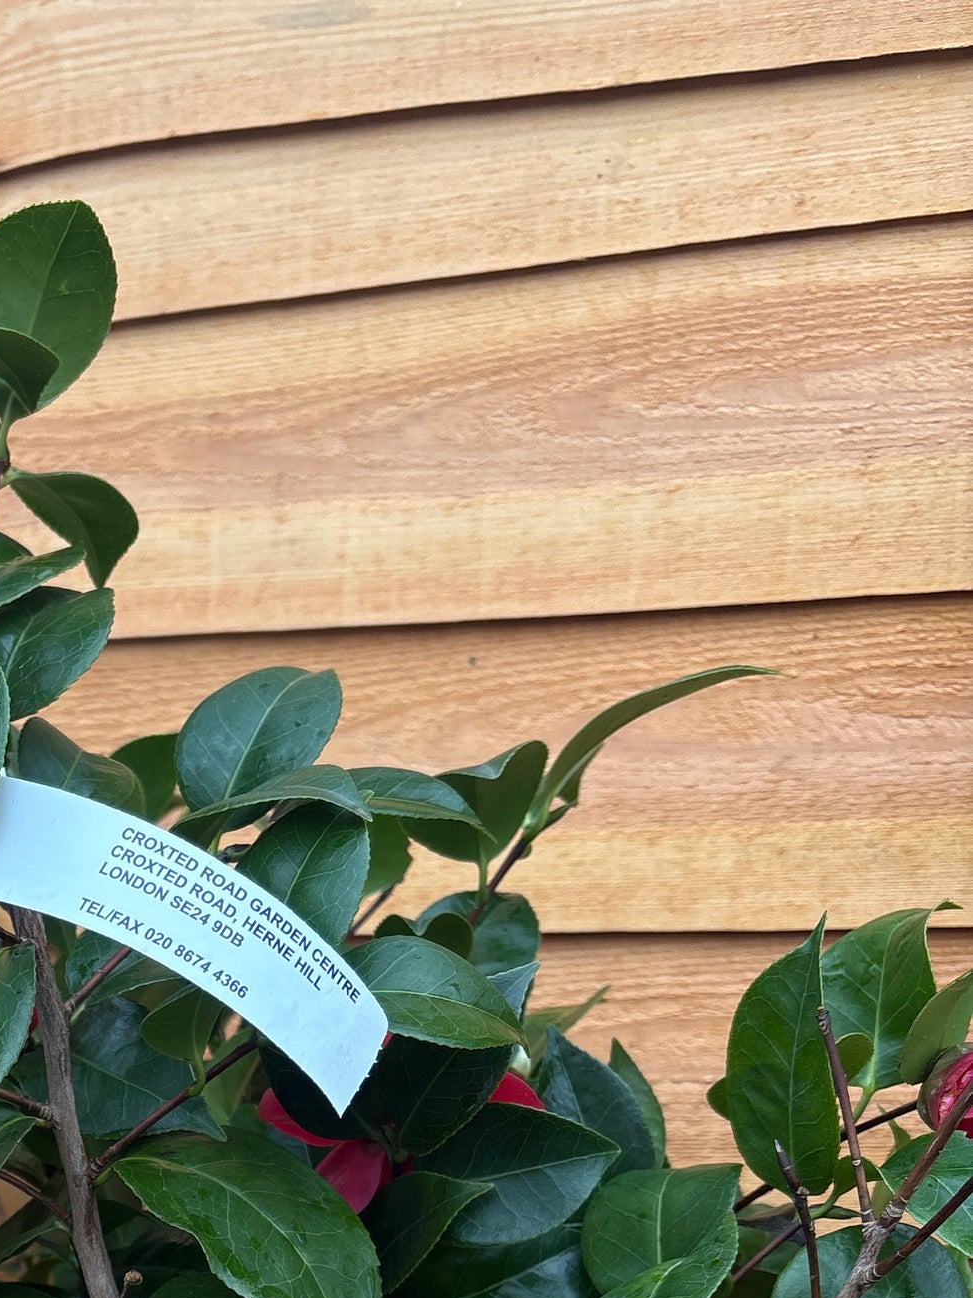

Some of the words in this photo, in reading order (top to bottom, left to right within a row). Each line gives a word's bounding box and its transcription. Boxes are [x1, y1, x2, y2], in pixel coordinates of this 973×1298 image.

[79, 897, 144, 935] TEL/FAX
[144, 927, 173, 951] 020
[175, 944, 213, 974] 8674
[212, 970, 249, 998] 4366
[99, 861, 169, 902] LONDON
[170, 895, 210, 926] SE24
[211, 920, 245, 947] 9DB
[111, 845, 188, 888] CROXTED
[189, 883, 237, 923] ROAD,
[242, 916, 295, 962] HERNE
[294, 957, 322, 991] HILL
[122, 828, 199, 872] CROXTED
[200, 866, 247, 901] ROAD
[250, 898, 312, 952] GARDEN
[312, 948, 361, 1004] CENTRE
